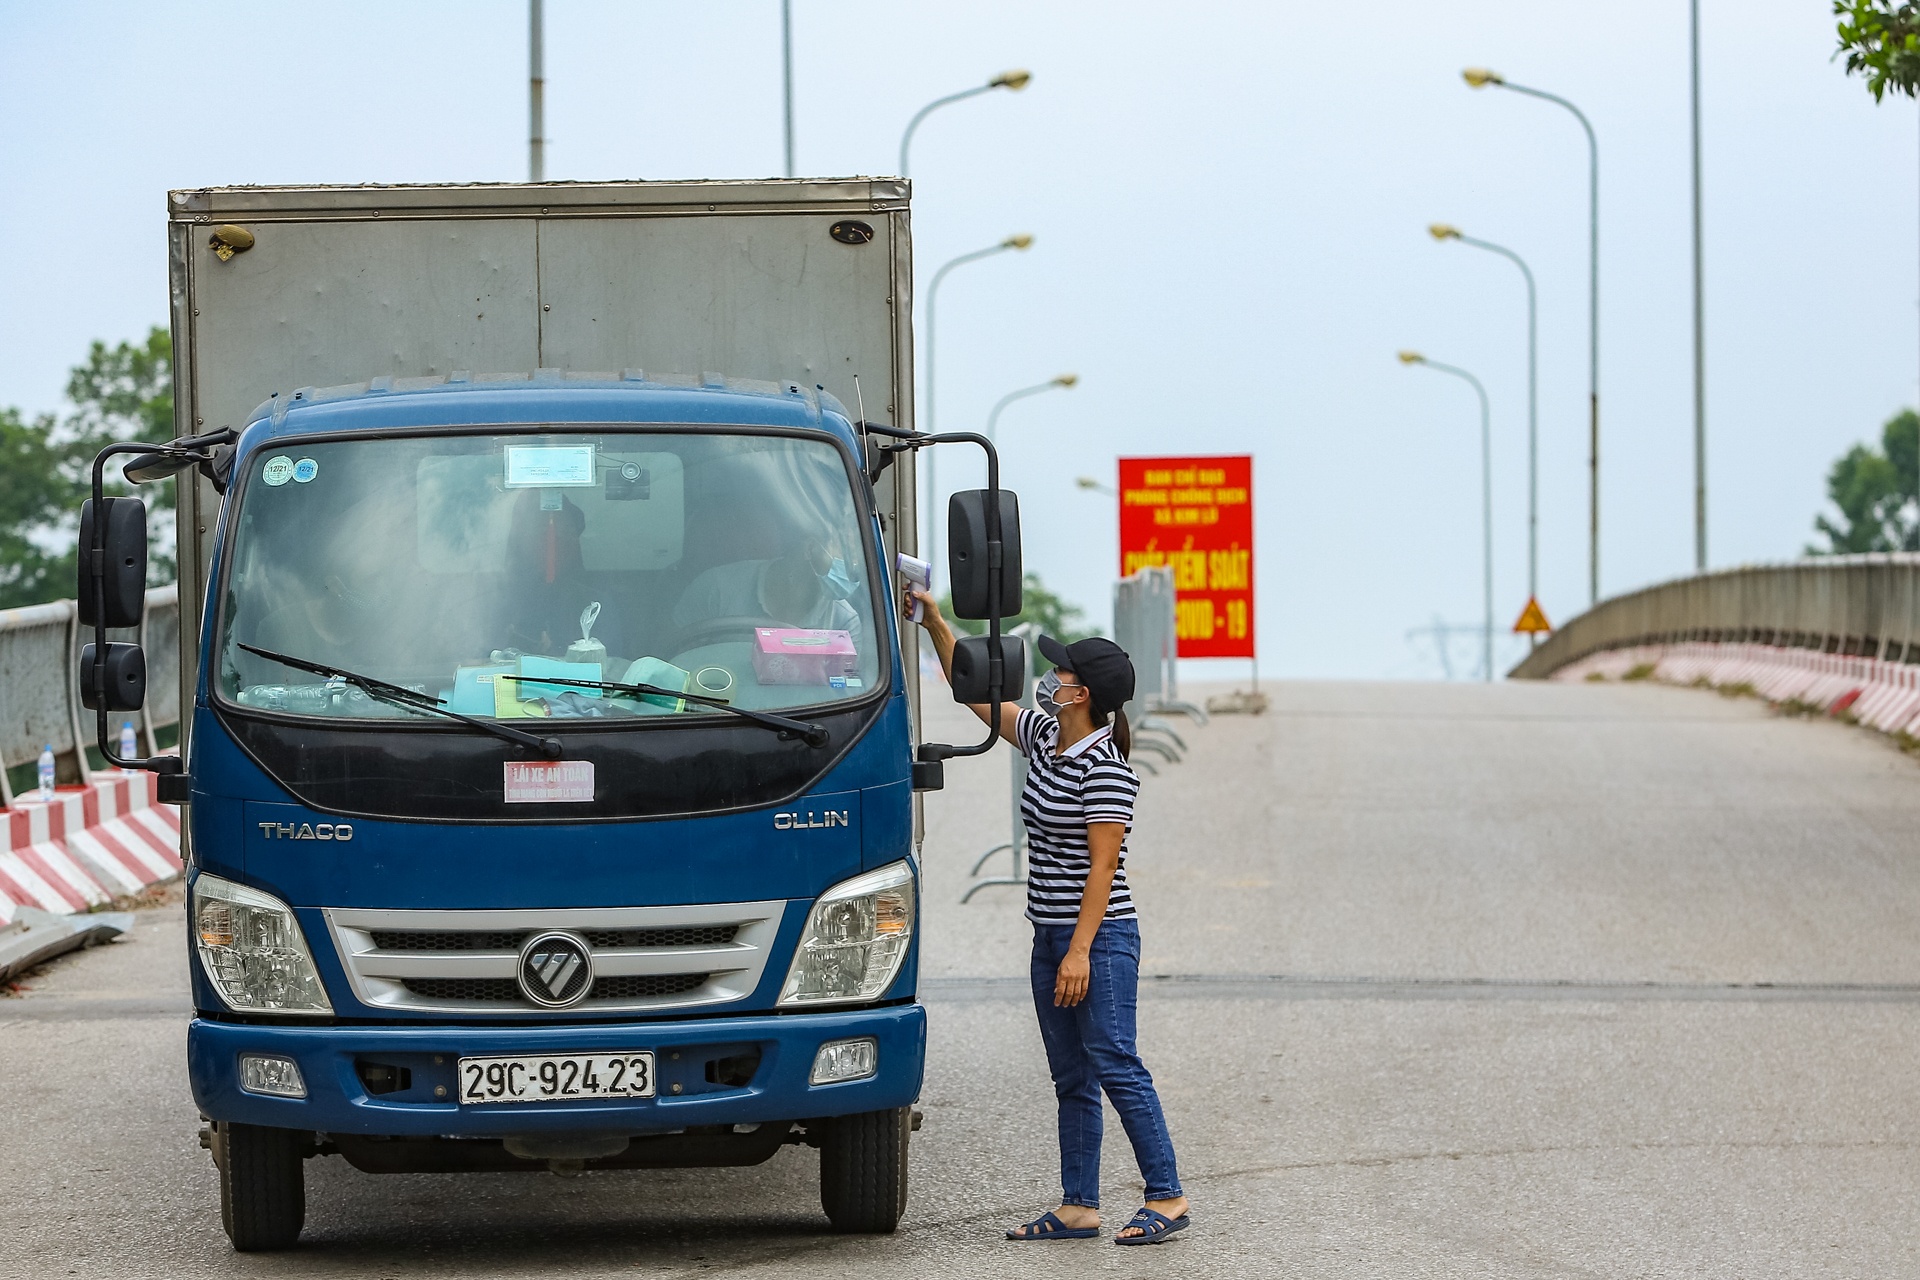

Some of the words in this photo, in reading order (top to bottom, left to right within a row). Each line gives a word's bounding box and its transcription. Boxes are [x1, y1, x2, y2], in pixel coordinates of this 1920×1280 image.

[1209, 542, 1249, 590] SOÁT
[1176, 599, 1214, 640] OVID
[1226, 598, 1247, 639] 19
[513, 765, 529, 782] LÁI
[531, 767, 545, 782] XE
[547, 767, 560, 782] AN
[259, 822, 353, 841] THACO
[774, 810, 848, 830] OLLIN
[466, 1058, 648, 1100] 29C-924.23
